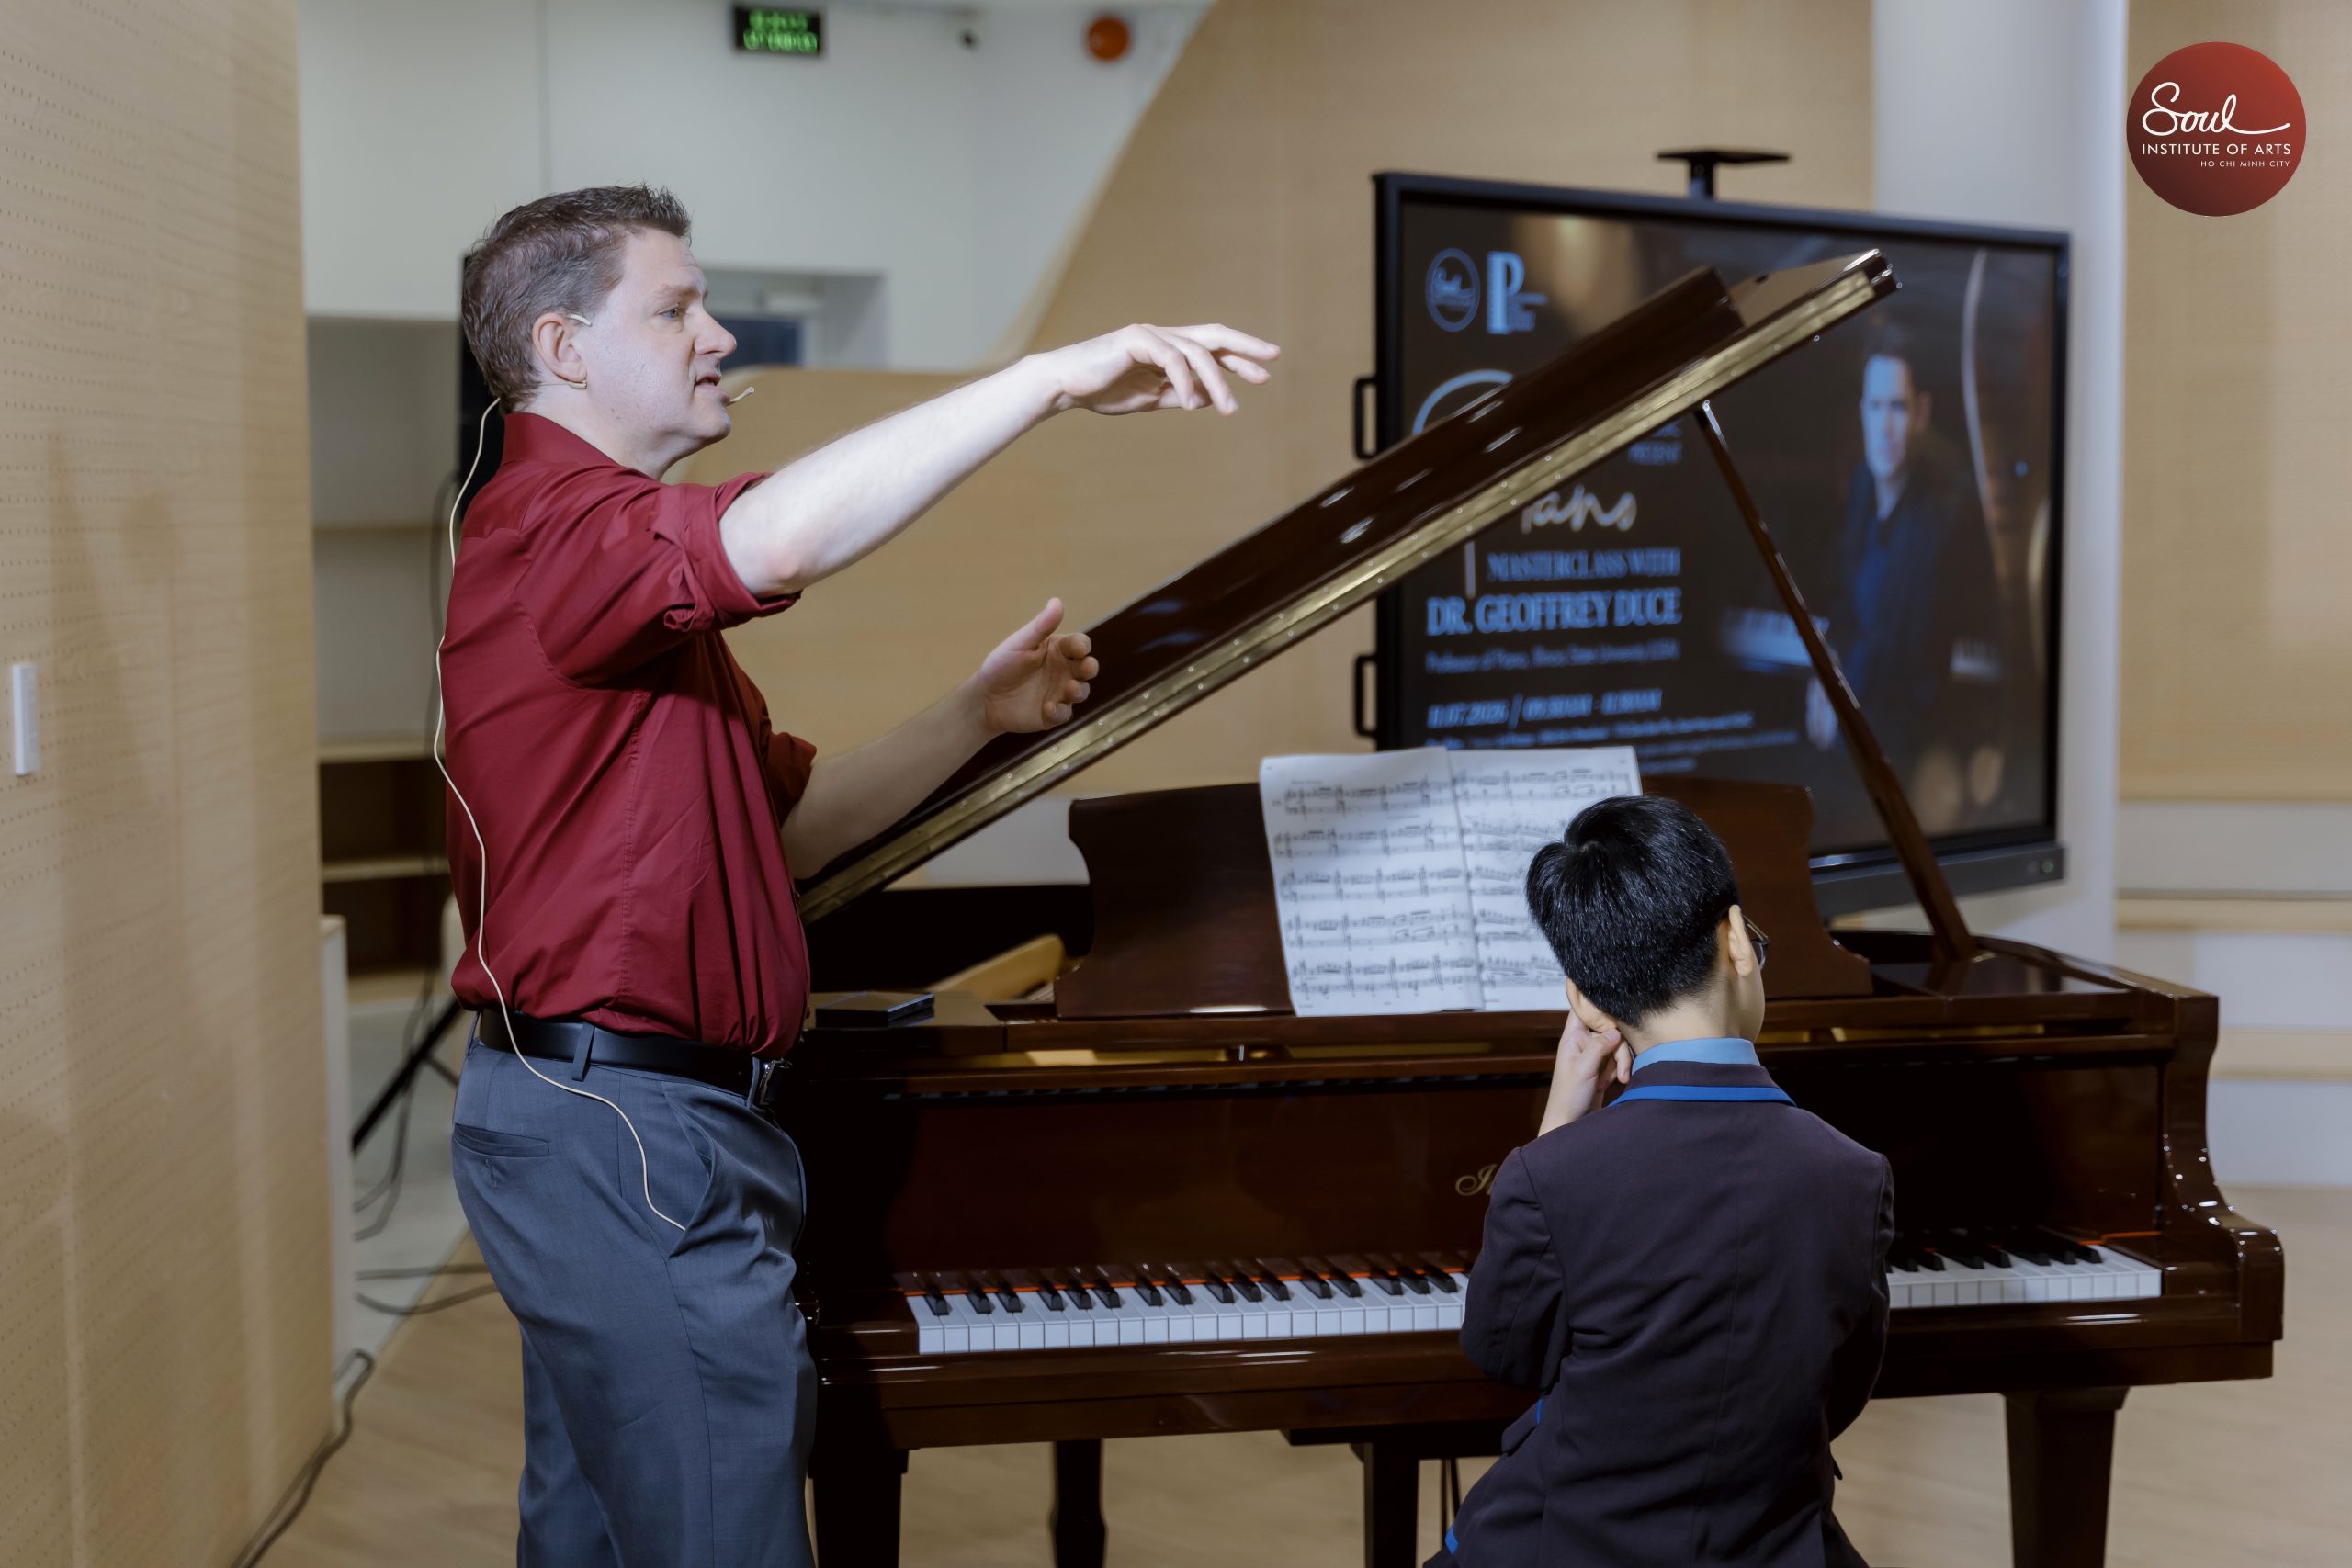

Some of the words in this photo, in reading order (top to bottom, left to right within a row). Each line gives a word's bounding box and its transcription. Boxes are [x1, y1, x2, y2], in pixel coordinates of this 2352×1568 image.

[1487, 549, 1627, 582] MASTERCLASS
[1426, 597, 1474, 637] DR.
[1475, 590, 1611, 634] GEOFFREY
[1612, 587, 1683, 627] DUCE
